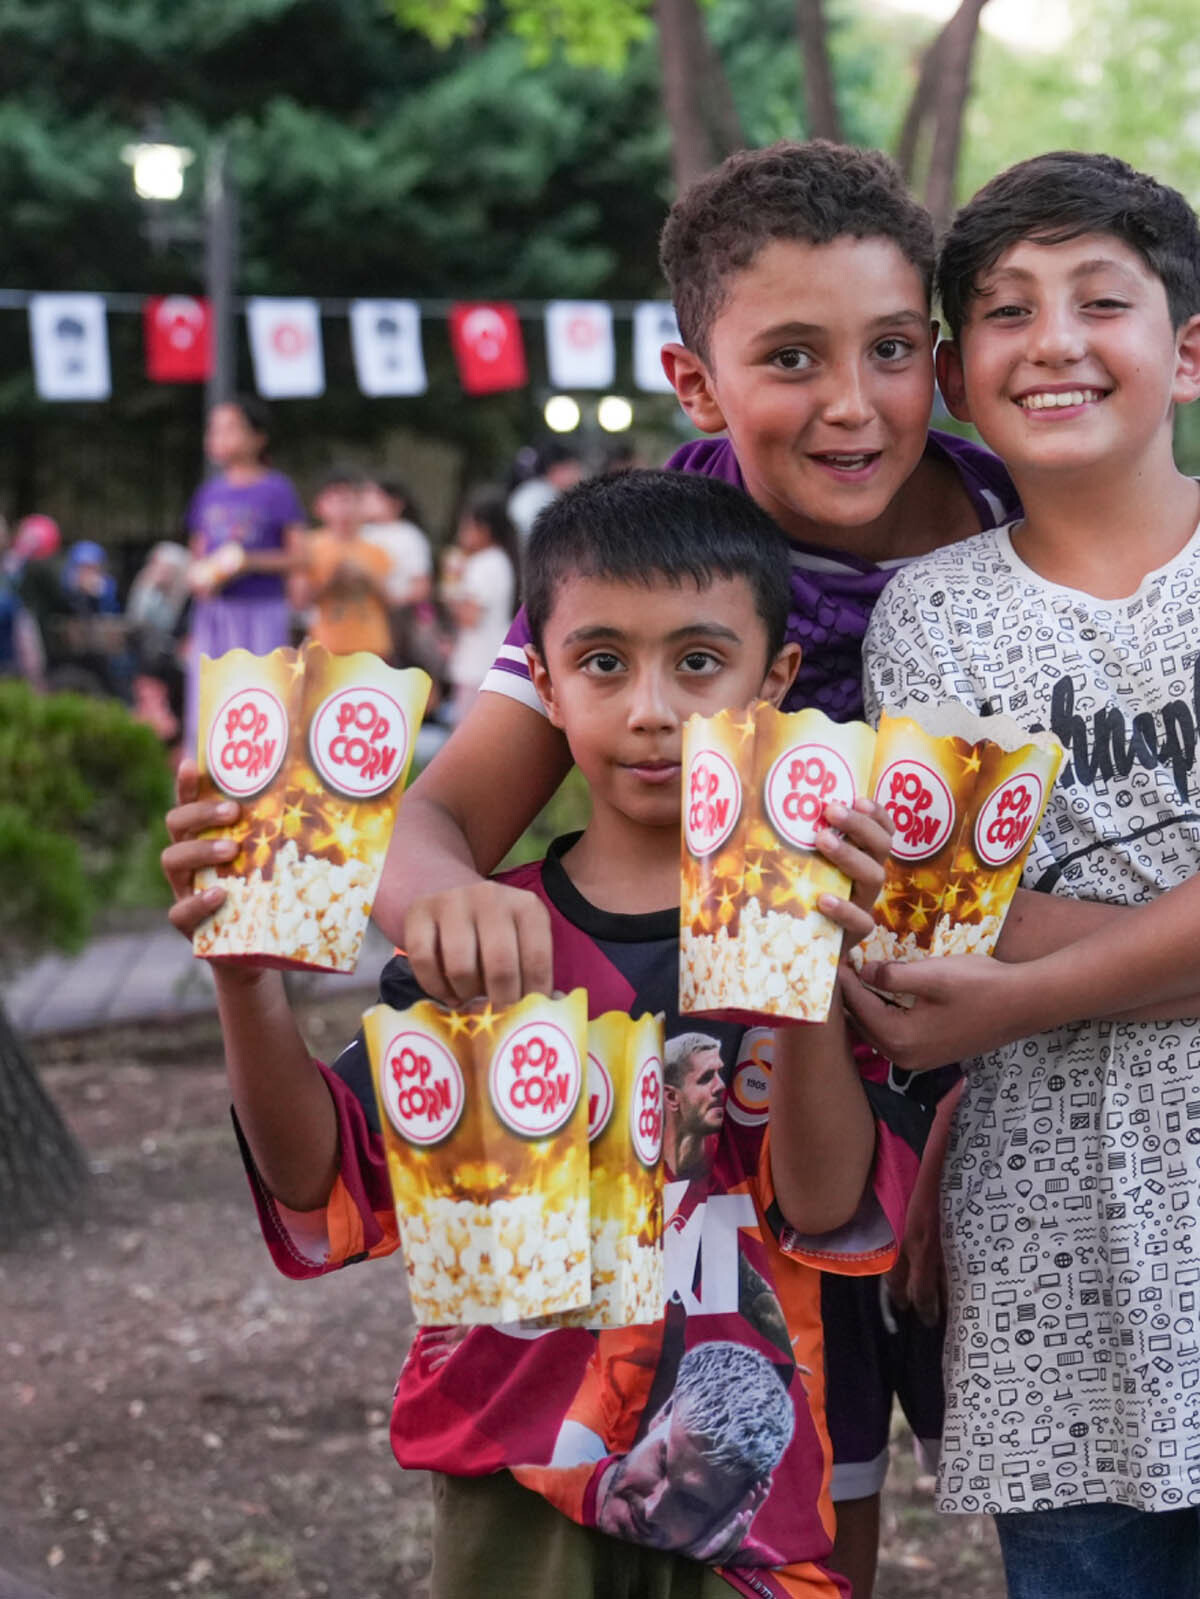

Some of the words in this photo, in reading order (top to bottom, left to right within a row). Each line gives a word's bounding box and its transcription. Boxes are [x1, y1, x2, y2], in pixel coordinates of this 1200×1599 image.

[225, 702, 269, 742] POP
[336, 702, 390, 745] POP
[220, 739, 277, 777] CORN
[328, 734, 398, 780] CORN
[690, 763, 720, 801] POP
[787, 757, 838, 799] POP
[888, 771, 934, 813] POP
[689, 796, 730, 836] CORN
[997, 784, 1032, 817] POP
[986, 813, 1031, 850] CORN
[391, 1047, 432, 1088] POP
[511, 1036, 559, 1078] POP
[397, 1078, 452, 1123] CORN
[509, 1073, 570, 1115] CORN
[746, 1078, 767, 1091] 1905
